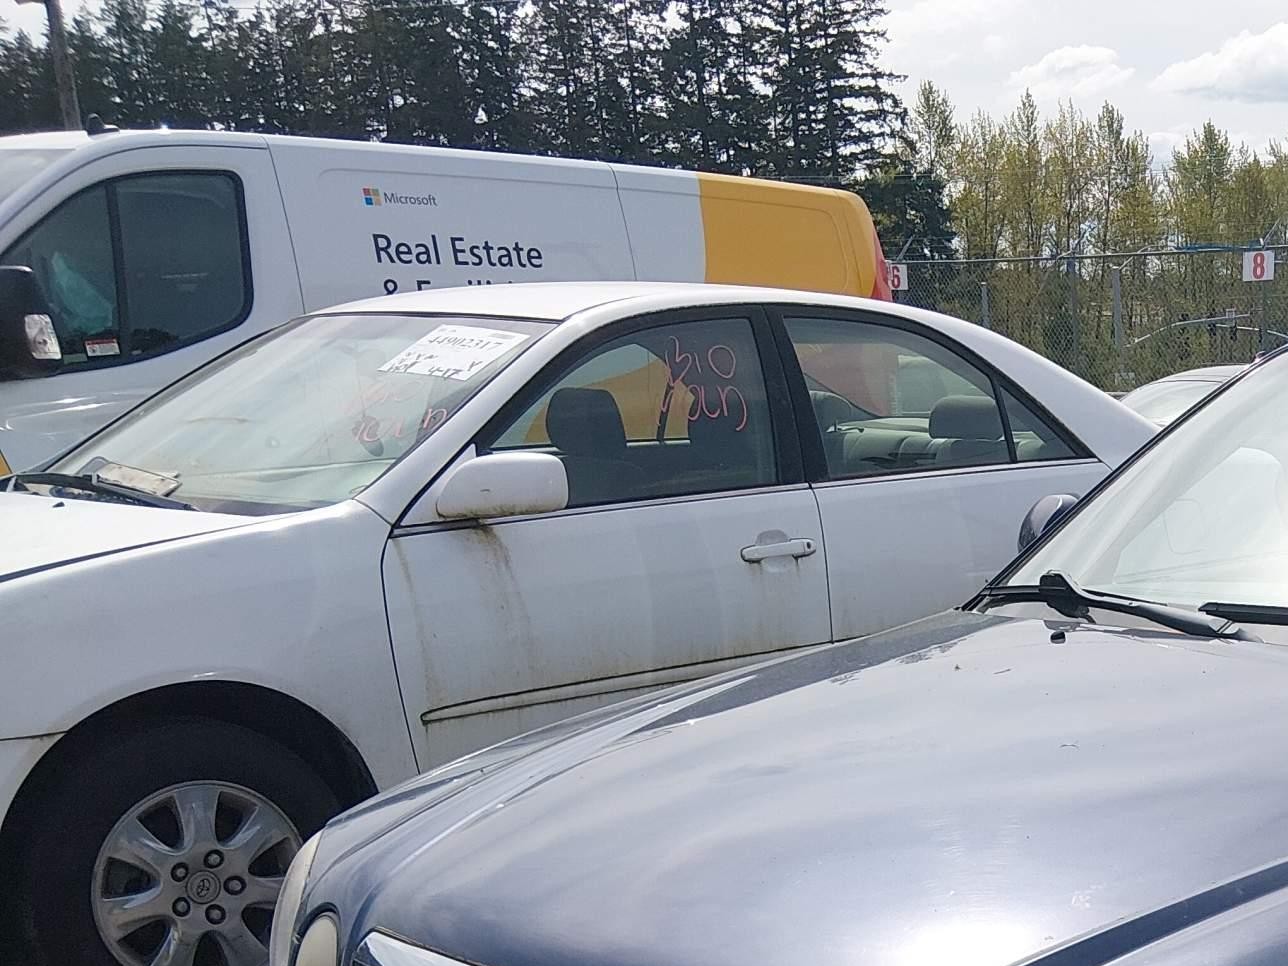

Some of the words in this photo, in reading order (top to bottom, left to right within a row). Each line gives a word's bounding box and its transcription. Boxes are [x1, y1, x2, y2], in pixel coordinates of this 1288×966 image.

[383, 192, 438, 206] Microsoft
[372, 233, 441, 265] Real
[450, 236, 543, 269] Estate
[1252, 252, 1266, 280] 8
